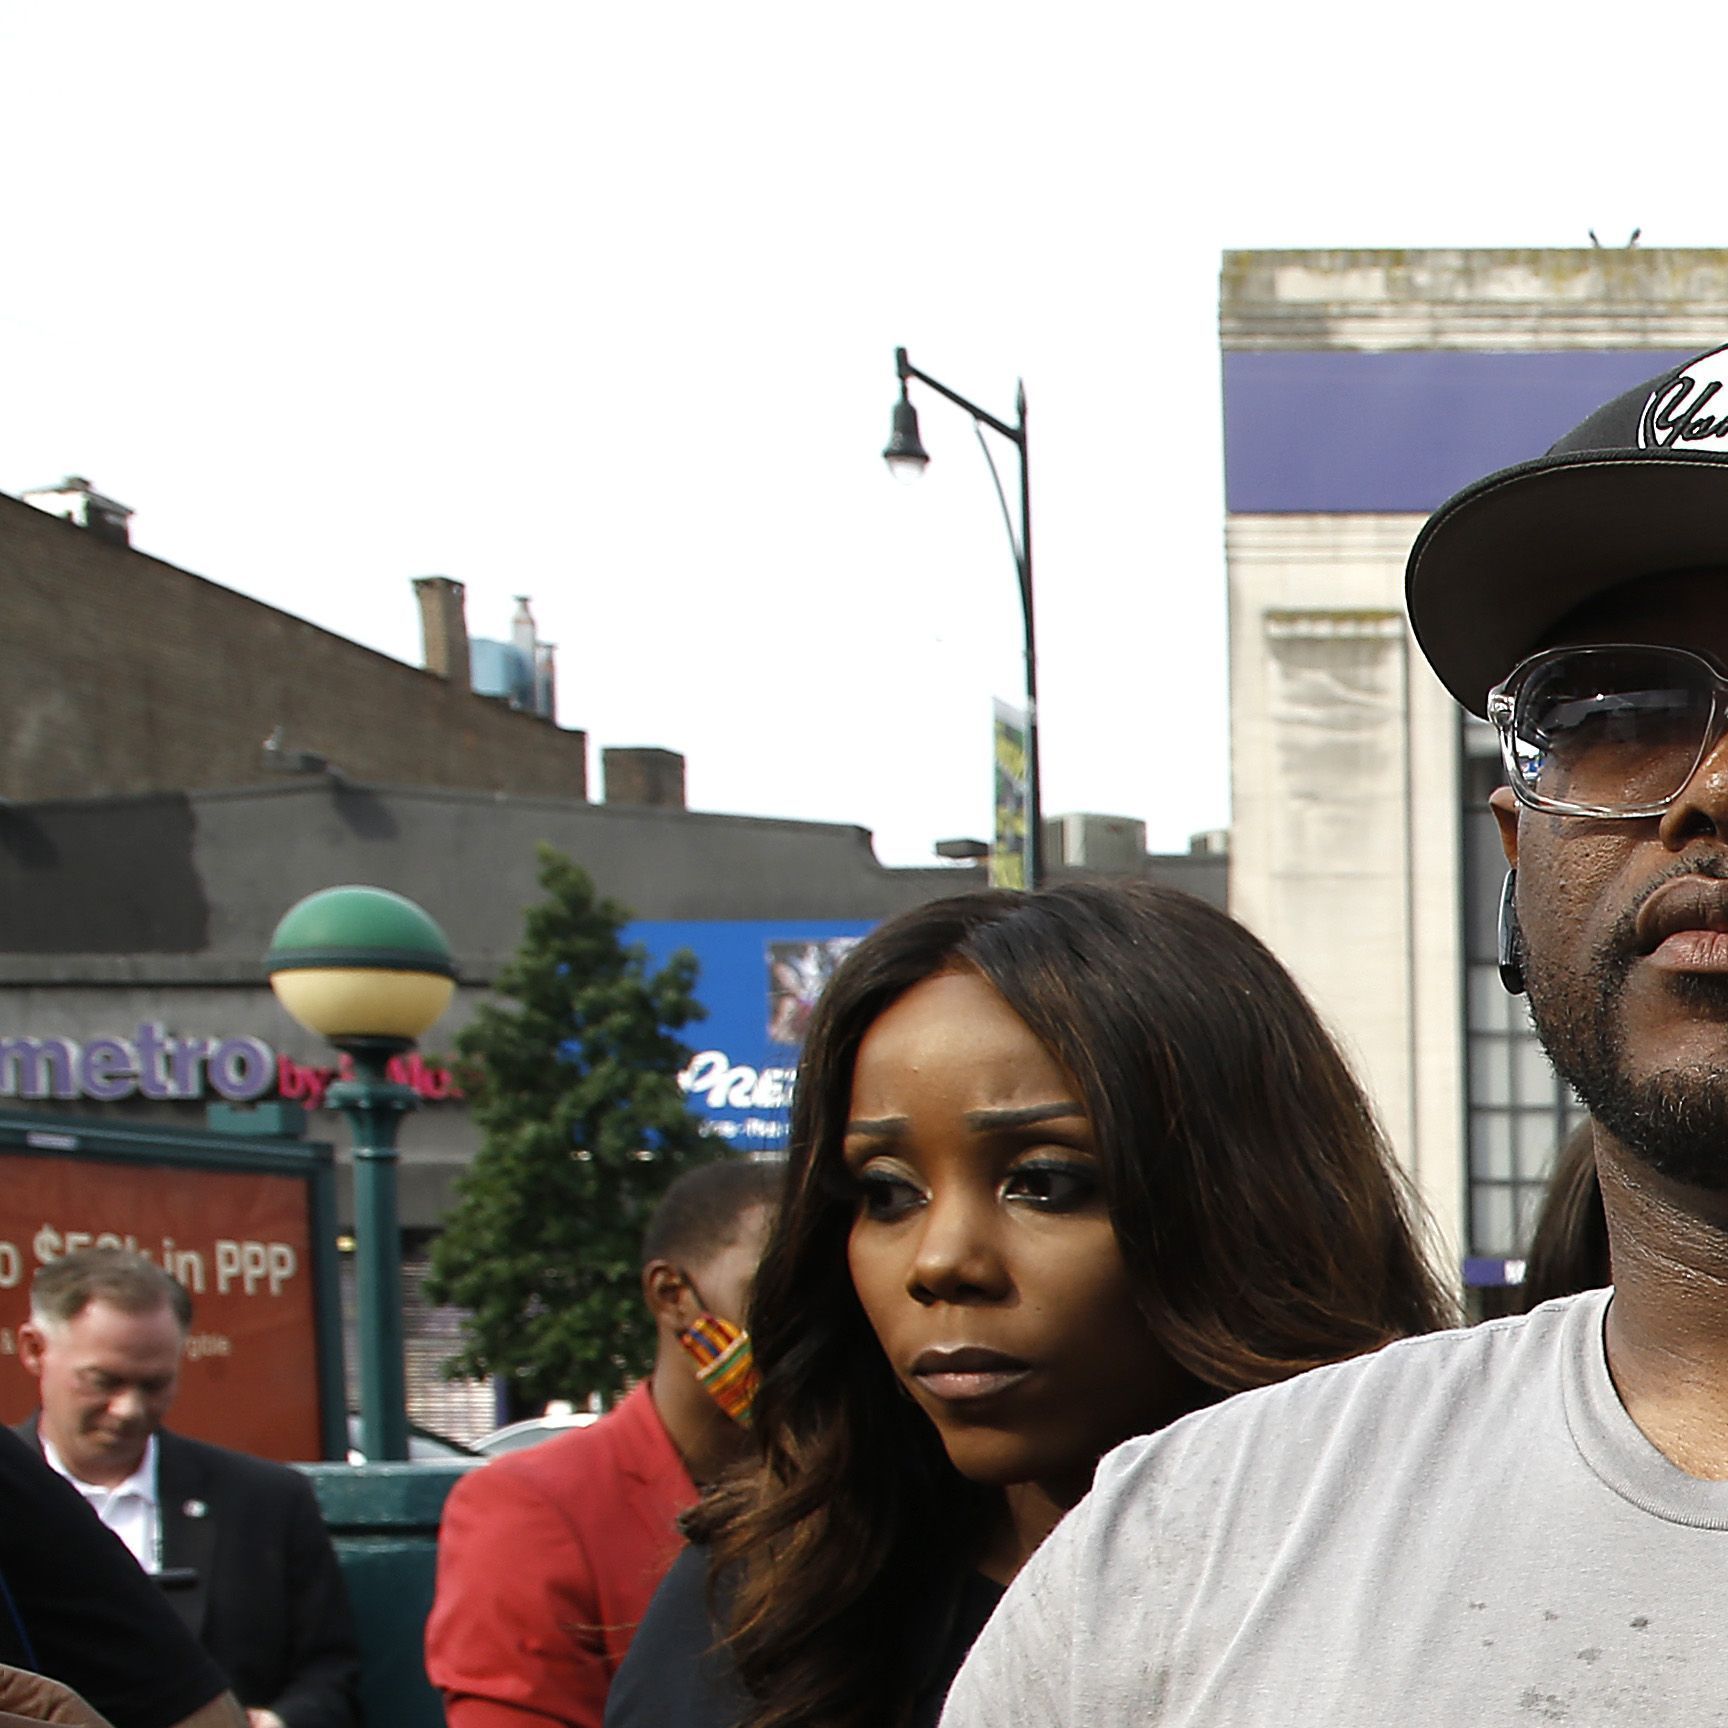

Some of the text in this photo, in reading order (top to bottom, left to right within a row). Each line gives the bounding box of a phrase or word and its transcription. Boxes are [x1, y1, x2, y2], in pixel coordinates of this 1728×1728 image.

[0, 1022, 276, 1101] metro
[278, 1052, 332, 1111] by
[215, 1239, 297, 1297] PPP
